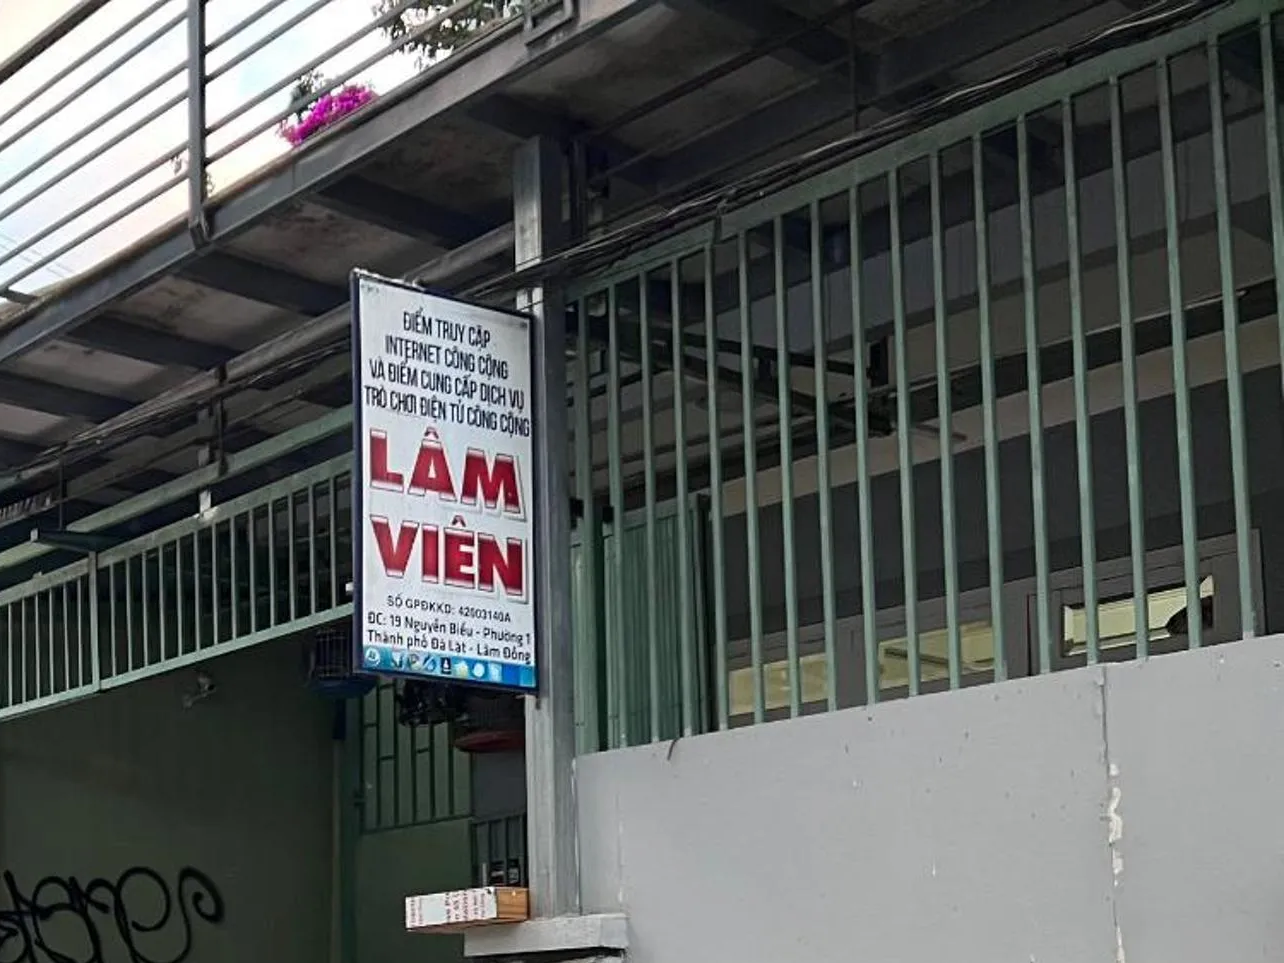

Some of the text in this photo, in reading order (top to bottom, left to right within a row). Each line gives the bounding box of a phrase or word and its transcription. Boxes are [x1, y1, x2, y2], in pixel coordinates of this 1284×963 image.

[435, 318, 465, 344] TRUY
[385, 334, 508, 380] INTERNET CÔNG CỘNG
[420, 369, 451, 394] CUNG
[369, 426, 525, 520] LÂM
[369, 514, 527, 600] VIÊN
